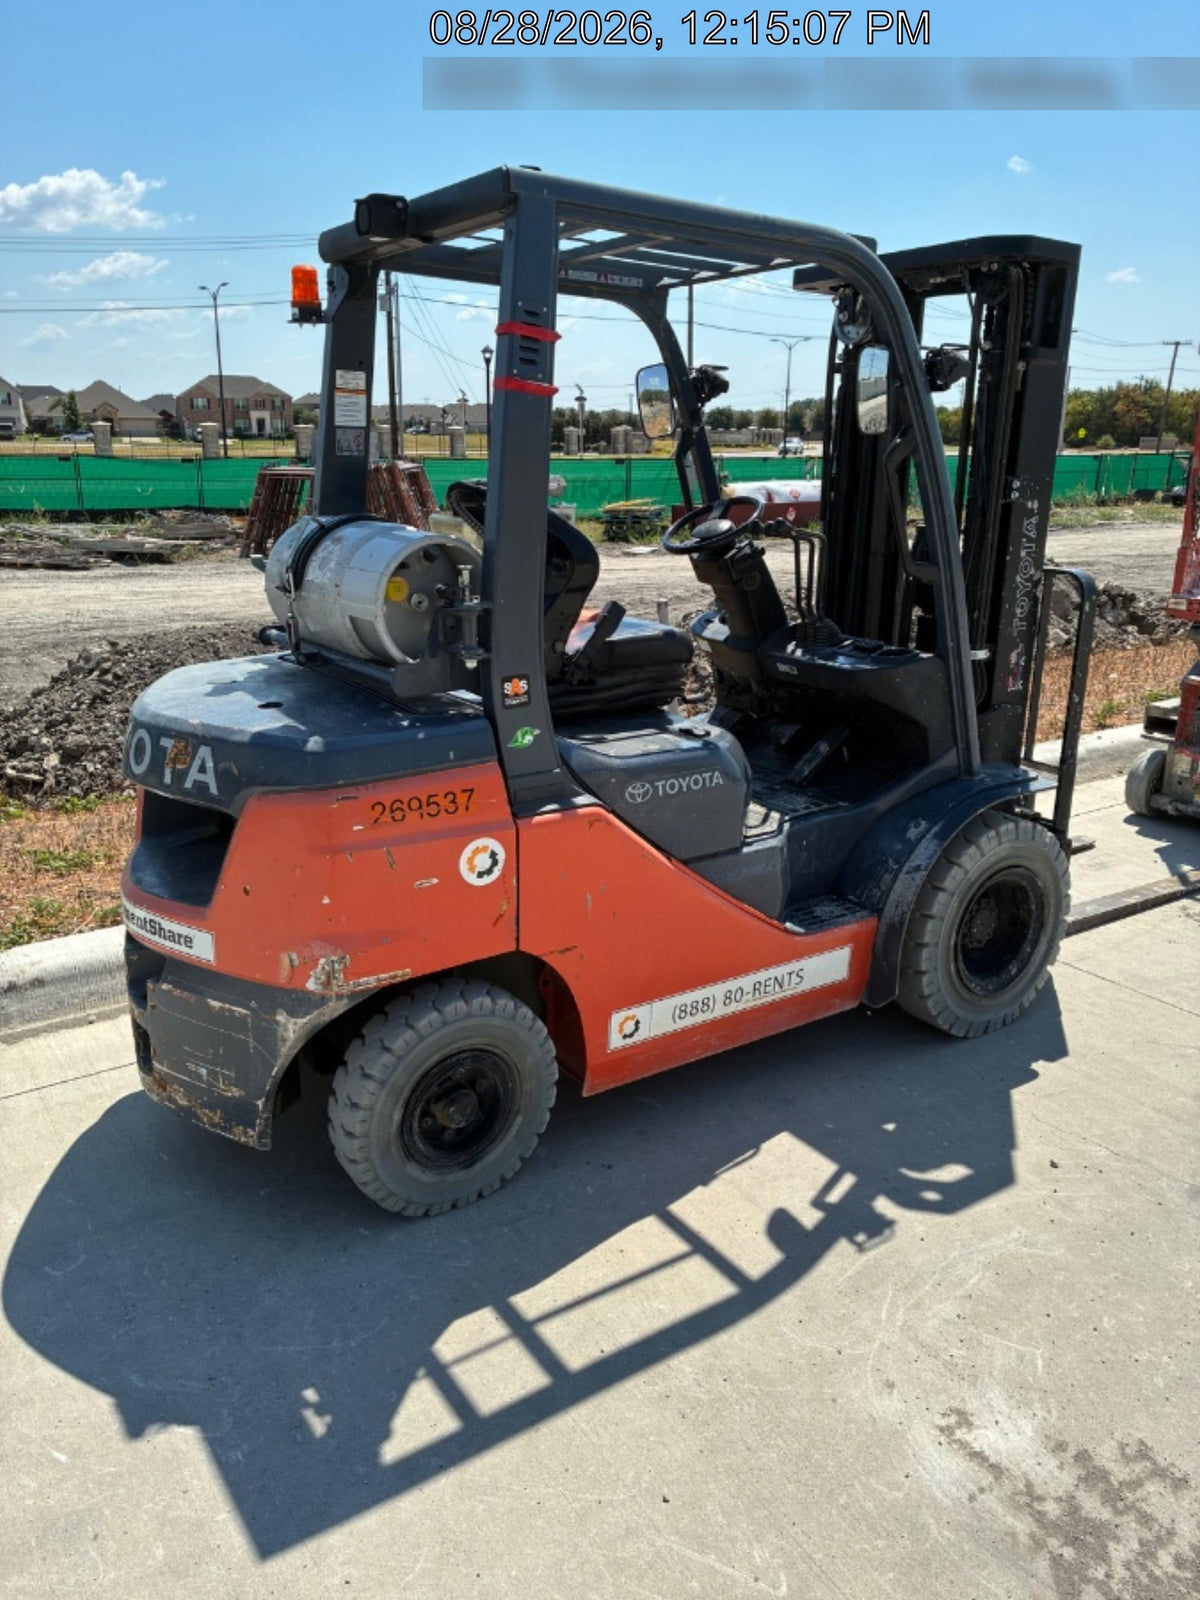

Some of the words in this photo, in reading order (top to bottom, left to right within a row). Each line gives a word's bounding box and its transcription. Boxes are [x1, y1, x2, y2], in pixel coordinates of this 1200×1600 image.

[1012, 516, 1039, 637] TOYOTA
[370, 788, 475, 825] 269537
[654, 771, 723, 796] TOYOTA
[672, 995, 717, 1024] (888)
[723, 968, 805, 1006] 80-RENTS
